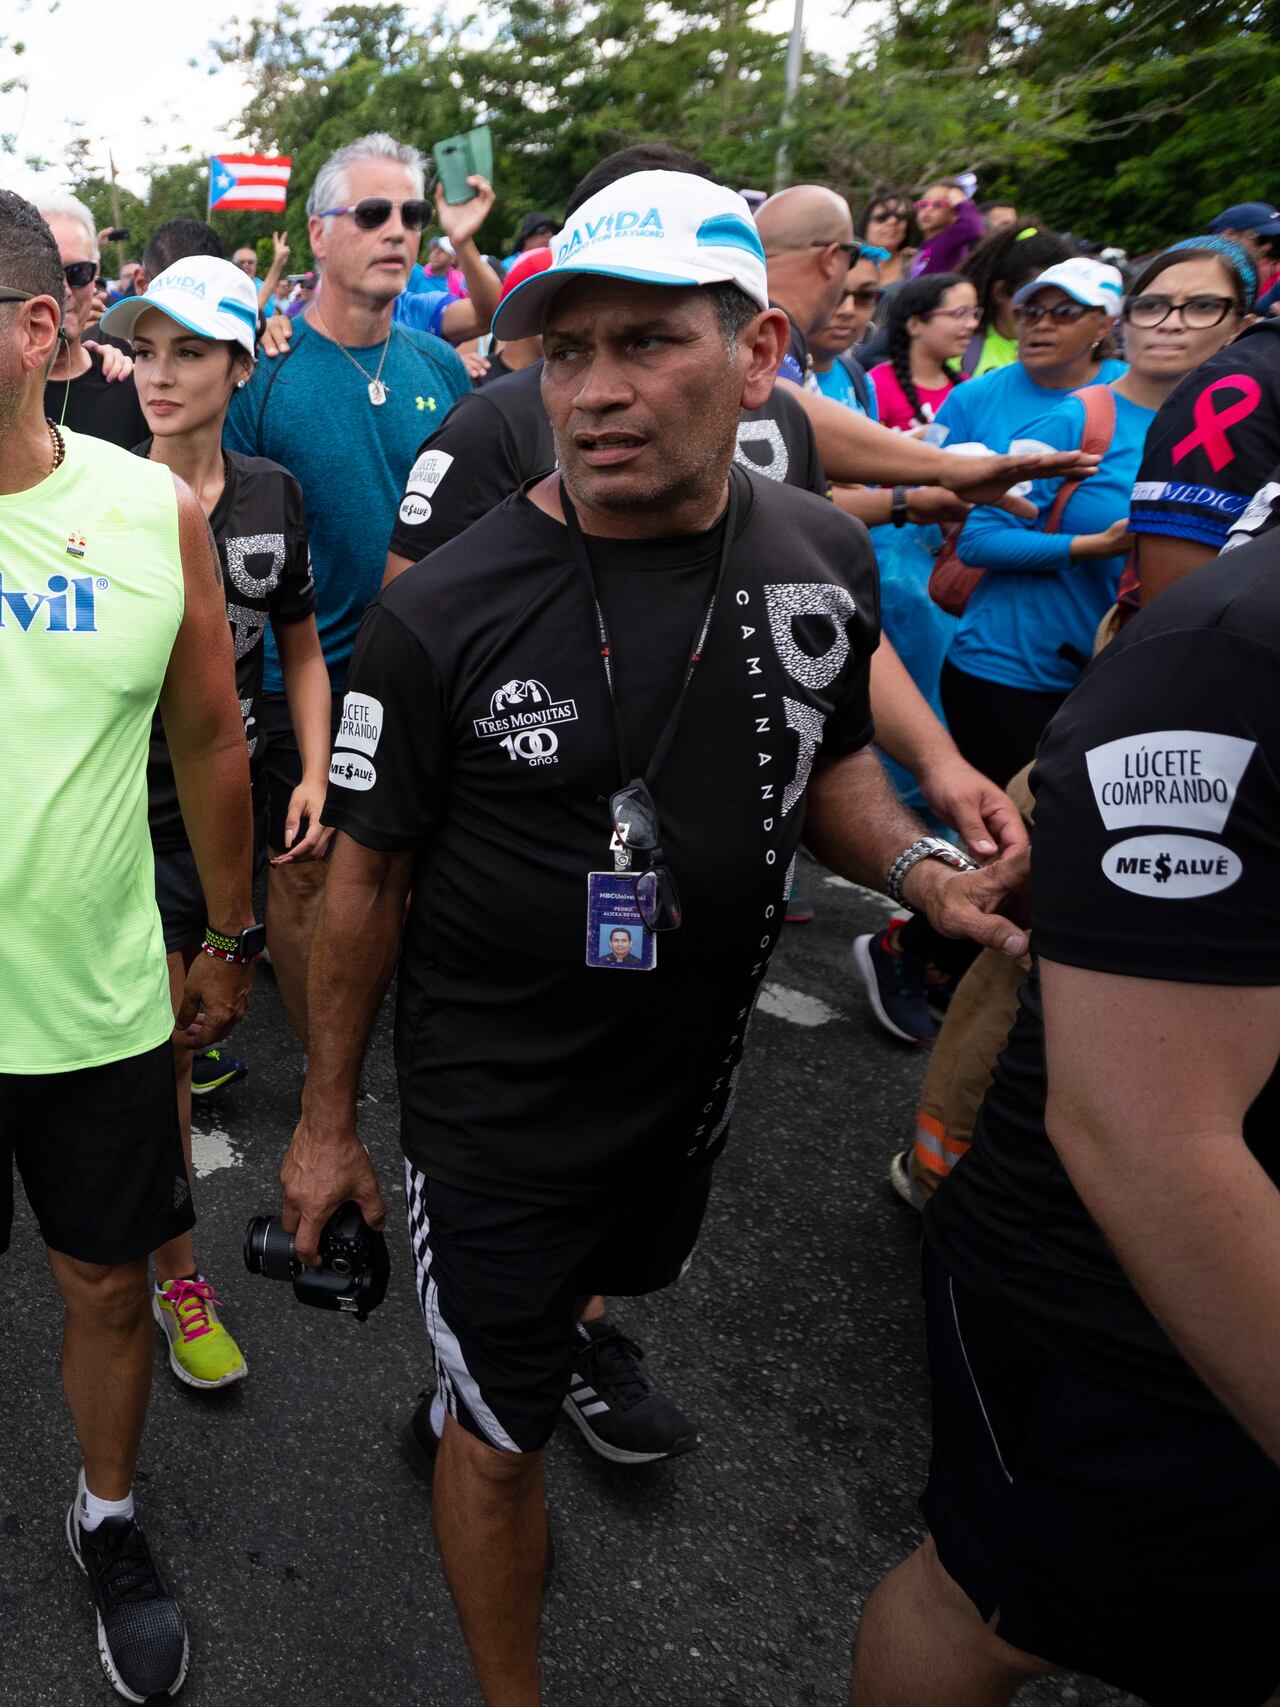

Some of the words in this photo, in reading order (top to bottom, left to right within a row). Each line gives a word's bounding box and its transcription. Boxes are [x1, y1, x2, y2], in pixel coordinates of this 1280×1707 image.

[340, 720, 378, 741] PRANDO
[479, 717, 510, 734] TRES
[510, 704, 572, 729] MONJITAS
[735, 589, 776, 866] CAMINANDO
[499, 728, 559, 761] 100
[528, 754, 560, 767] años
[1124, 745, 1202, 779] LÚCETE
[1101, 778, 1229, 806] COMPRANDO
[1115, 852, 1230, 884] ME$ALVÉ
[599, 891, 647, 902] NBCUniveal
